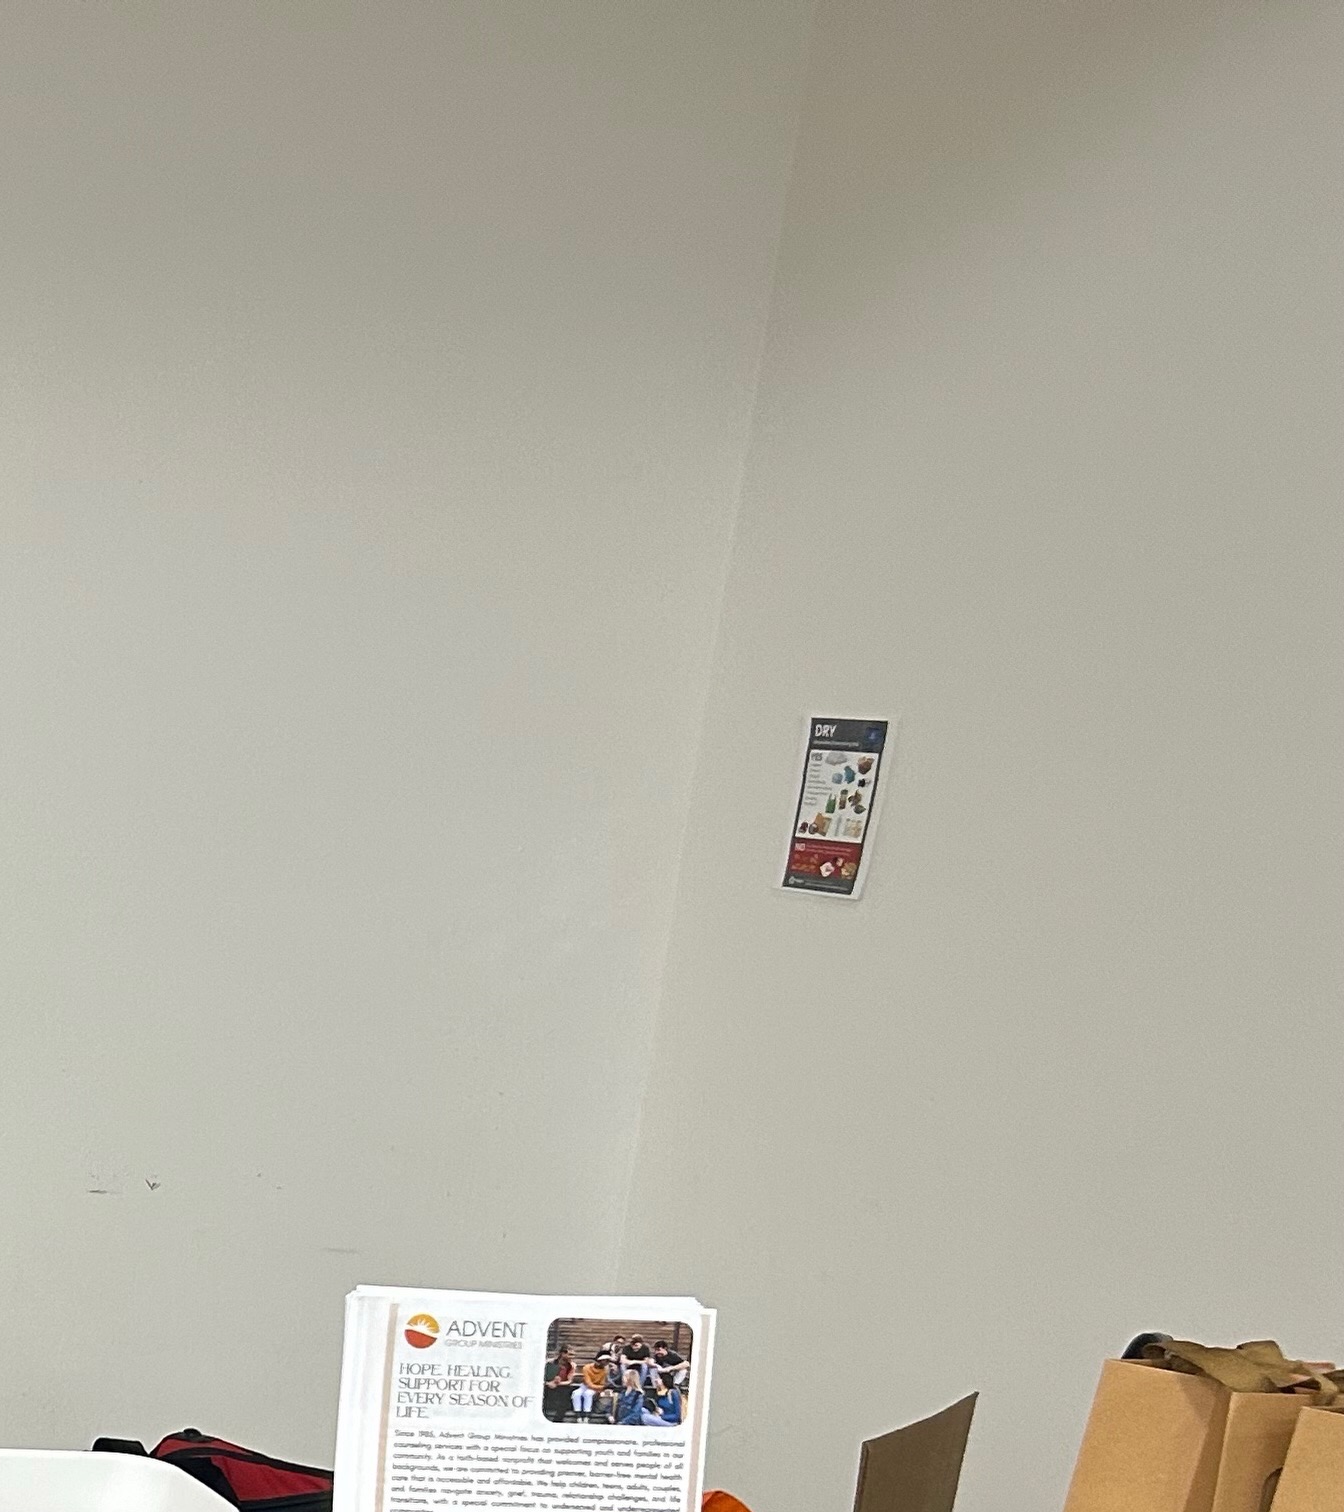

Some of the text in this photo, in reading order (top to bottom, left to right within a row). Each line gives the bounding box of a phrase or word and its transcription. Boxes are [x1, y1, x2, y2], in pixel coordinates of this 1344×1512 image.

[814, 724, 837, 737] DRY
[446, 1320, 528, 1338] ADVENT
[444, 1339, 477, 1347] GROUP
[398, 1377, 500, 1392] SUPPORT FOR
[397, 1392, 535, 1408] EVERY SEASON OF
